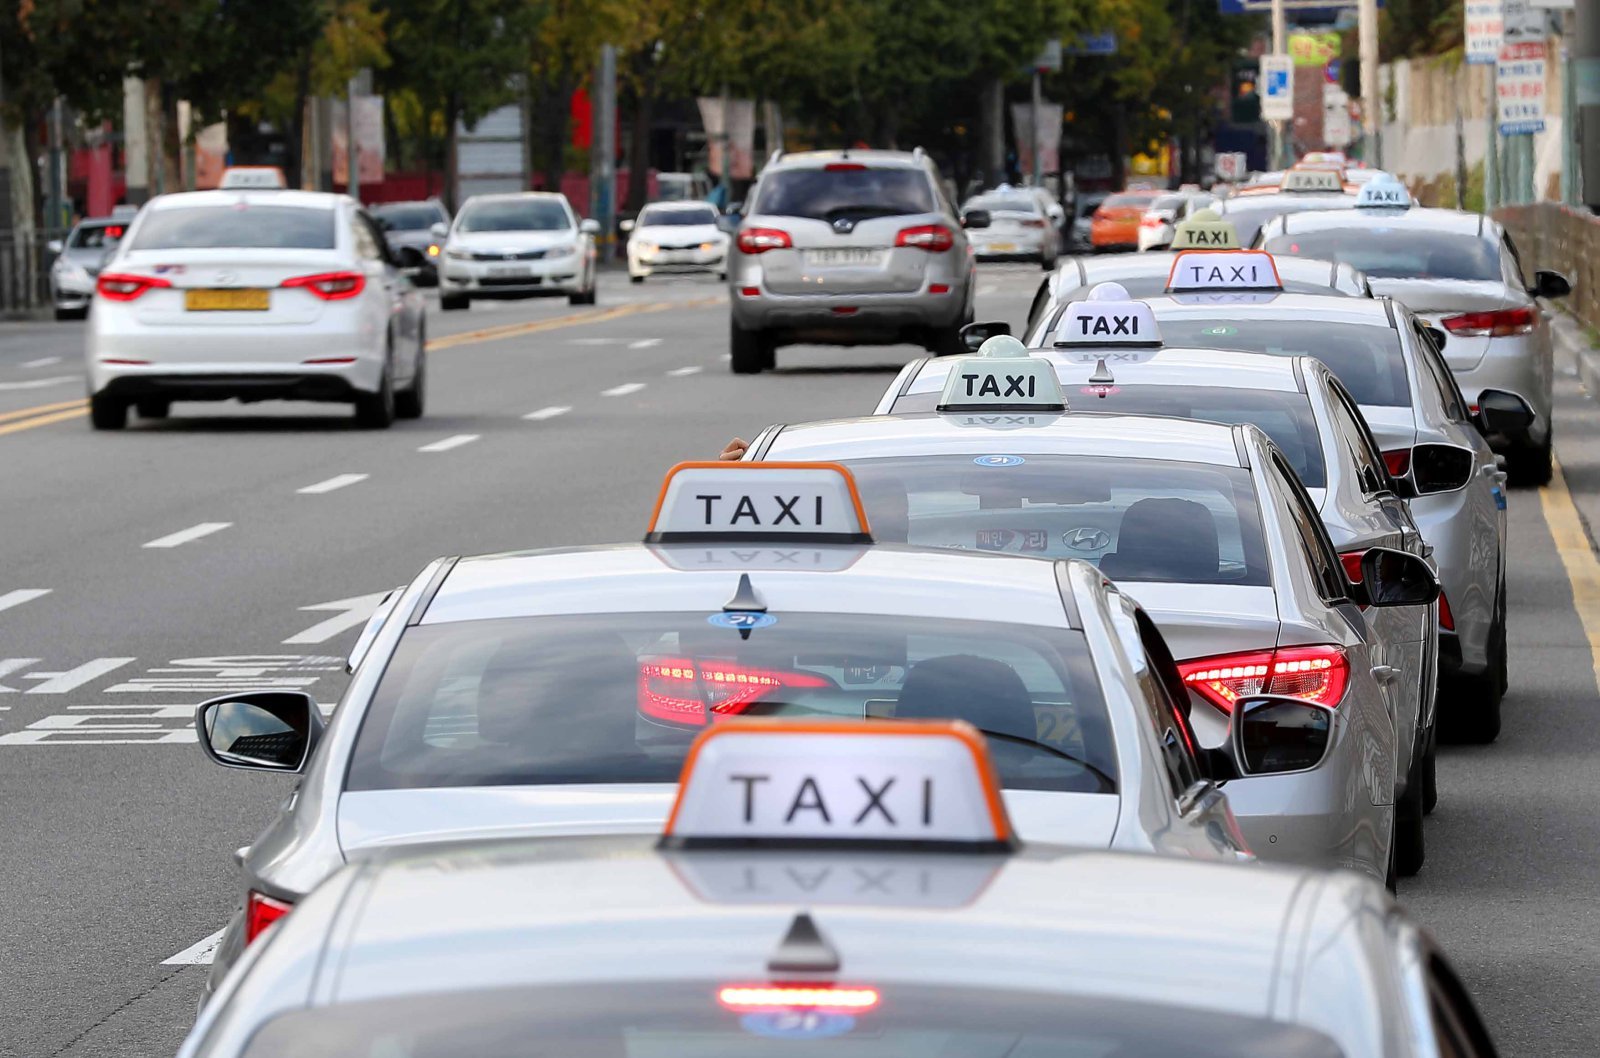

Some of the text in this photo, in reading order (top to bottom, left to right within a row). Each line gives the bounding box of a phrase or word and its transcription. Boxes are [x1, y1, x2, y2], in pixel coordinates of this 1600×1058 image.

[1294, 177, 1333, 188] TAXI
[1365, 190, 1400, 202] TAXI
[1186, 229, 1229, 245] TAXI
[1189, 265, 1257, 283] TAXI
[1077, 316, 1138, 336] TAXI
[961, 374, 1036, 398] TAXI
[696, 494, 823, 526] TAXI
[978, 529, 1046, 549] 개인 라
[729, 774, 934, 827] TAXI
